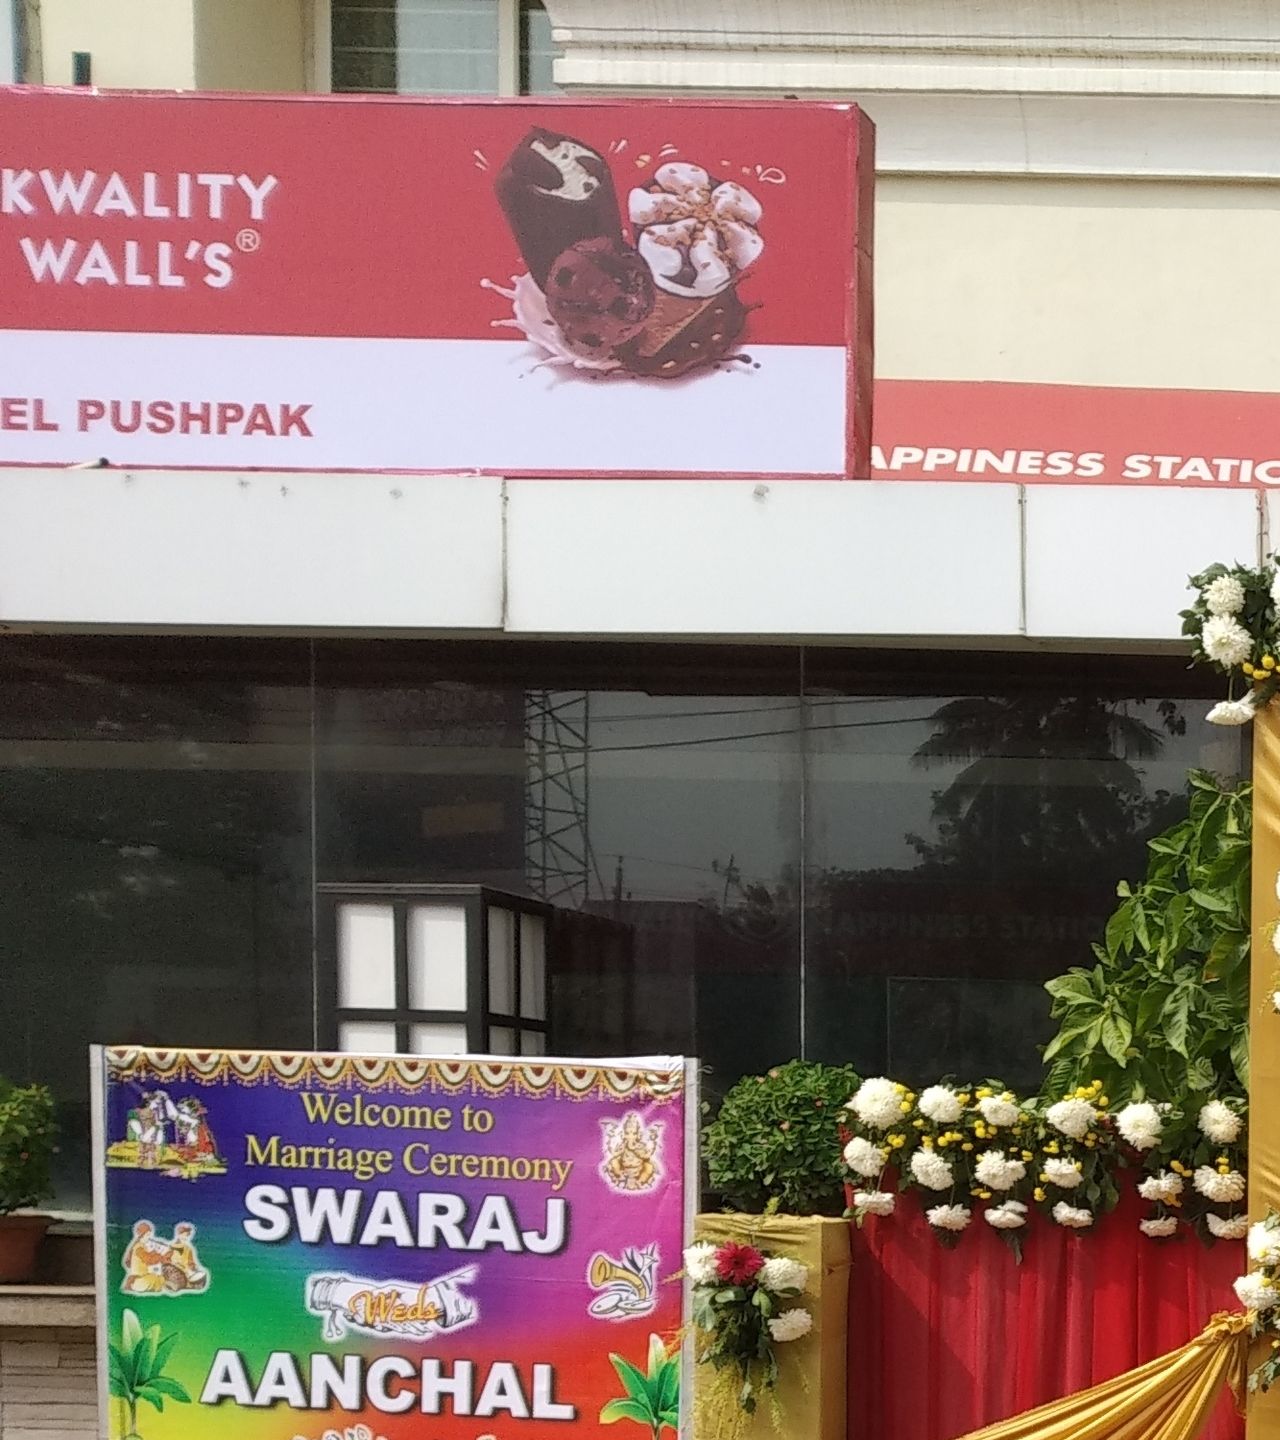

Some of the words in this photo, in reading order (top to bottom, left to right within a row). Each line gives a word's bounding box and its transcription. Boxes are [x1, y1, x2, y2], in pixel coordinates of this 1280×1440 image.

[1, 168, 278, 220] KWALITY
[1, 397, 59, 431] EL
[77, 399, 314, 437] PUSHPAK
[300, 1091, 451, 1131] Welcome
[463, 1104, 495, 1133] to
[245, 1134, 394, 1181] Marriage
[402, 1142, 574, 1190] Ceremony
[242, 1184, 567, 1254] SWARAJ
[348, 1282, 443, 1325] Weds
[200, 1348, 578, 1421] AANCHAL
